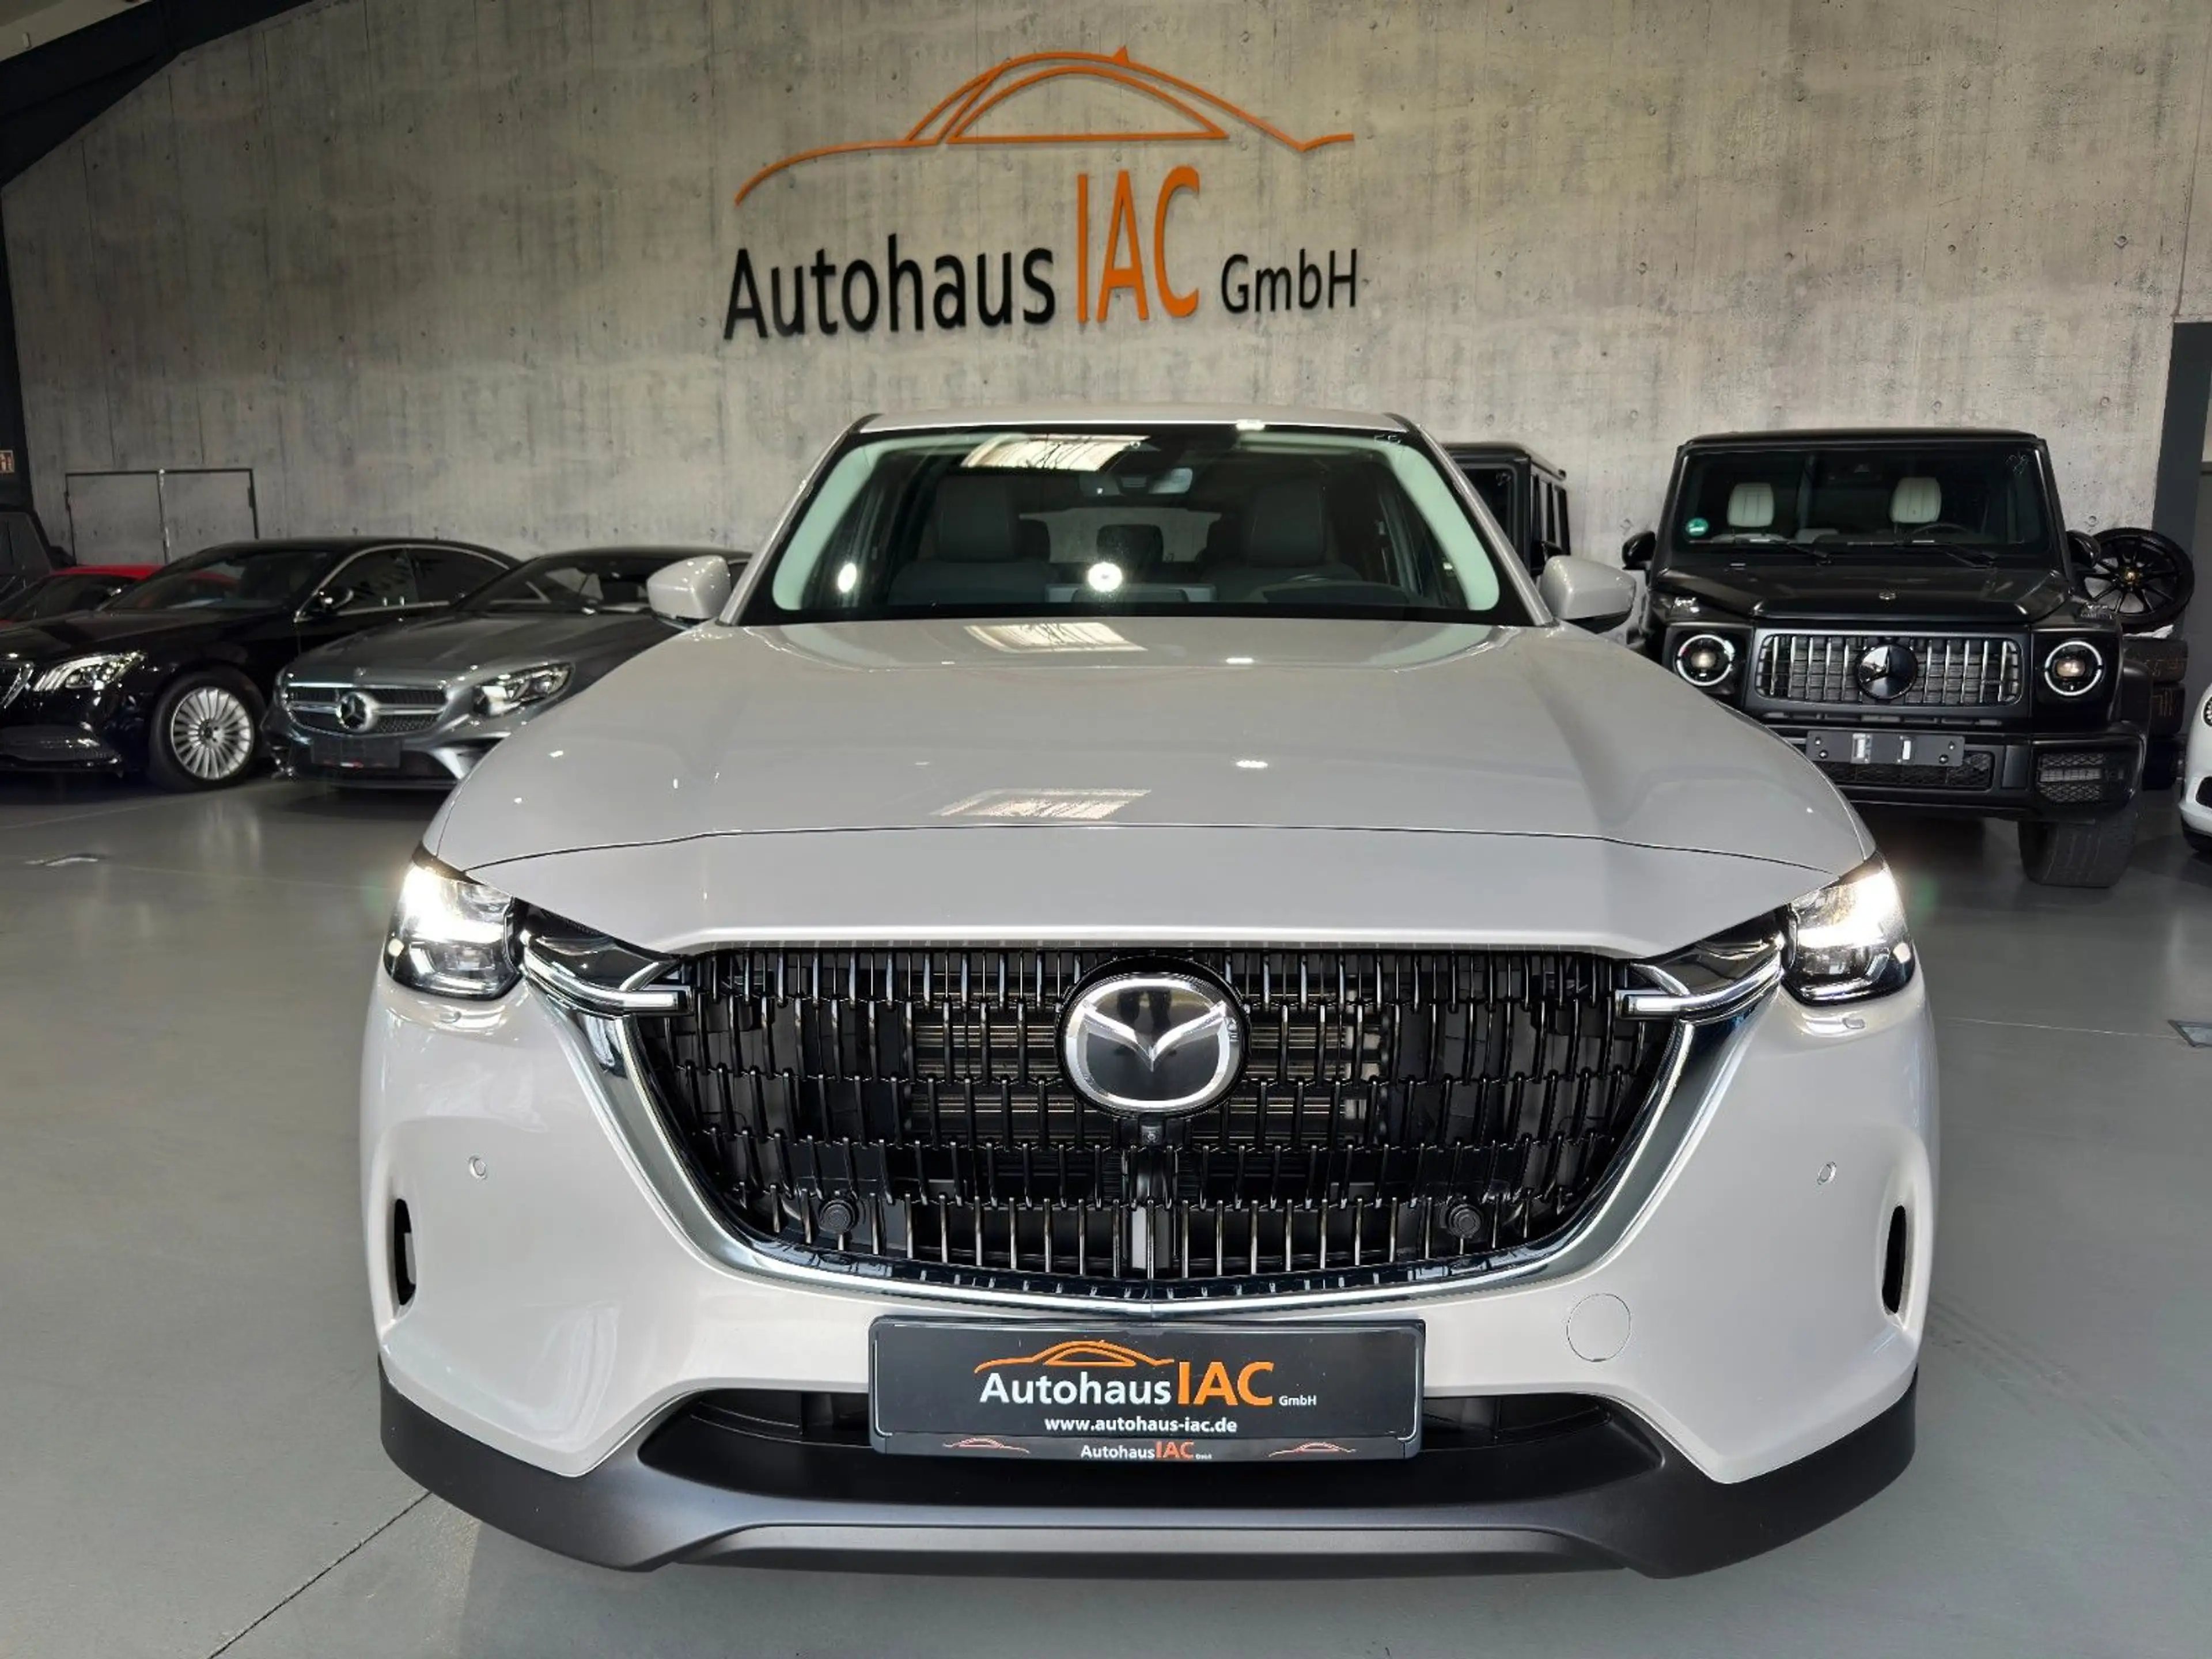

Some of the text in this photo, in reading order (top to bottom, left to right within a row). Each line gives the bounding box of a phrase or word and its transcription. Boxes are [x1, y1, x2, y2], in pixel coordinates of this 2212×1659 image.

[724, 165, 1358, 340] Autohaus IAC GmbH
[979, 1361, 1317, 1407] Autohaus IAC GmbH
[1044, 1415, 1237, 1433] www.autohaus-iac.de
[1080, 1441, 1194, 1459] Autohaus IAC
